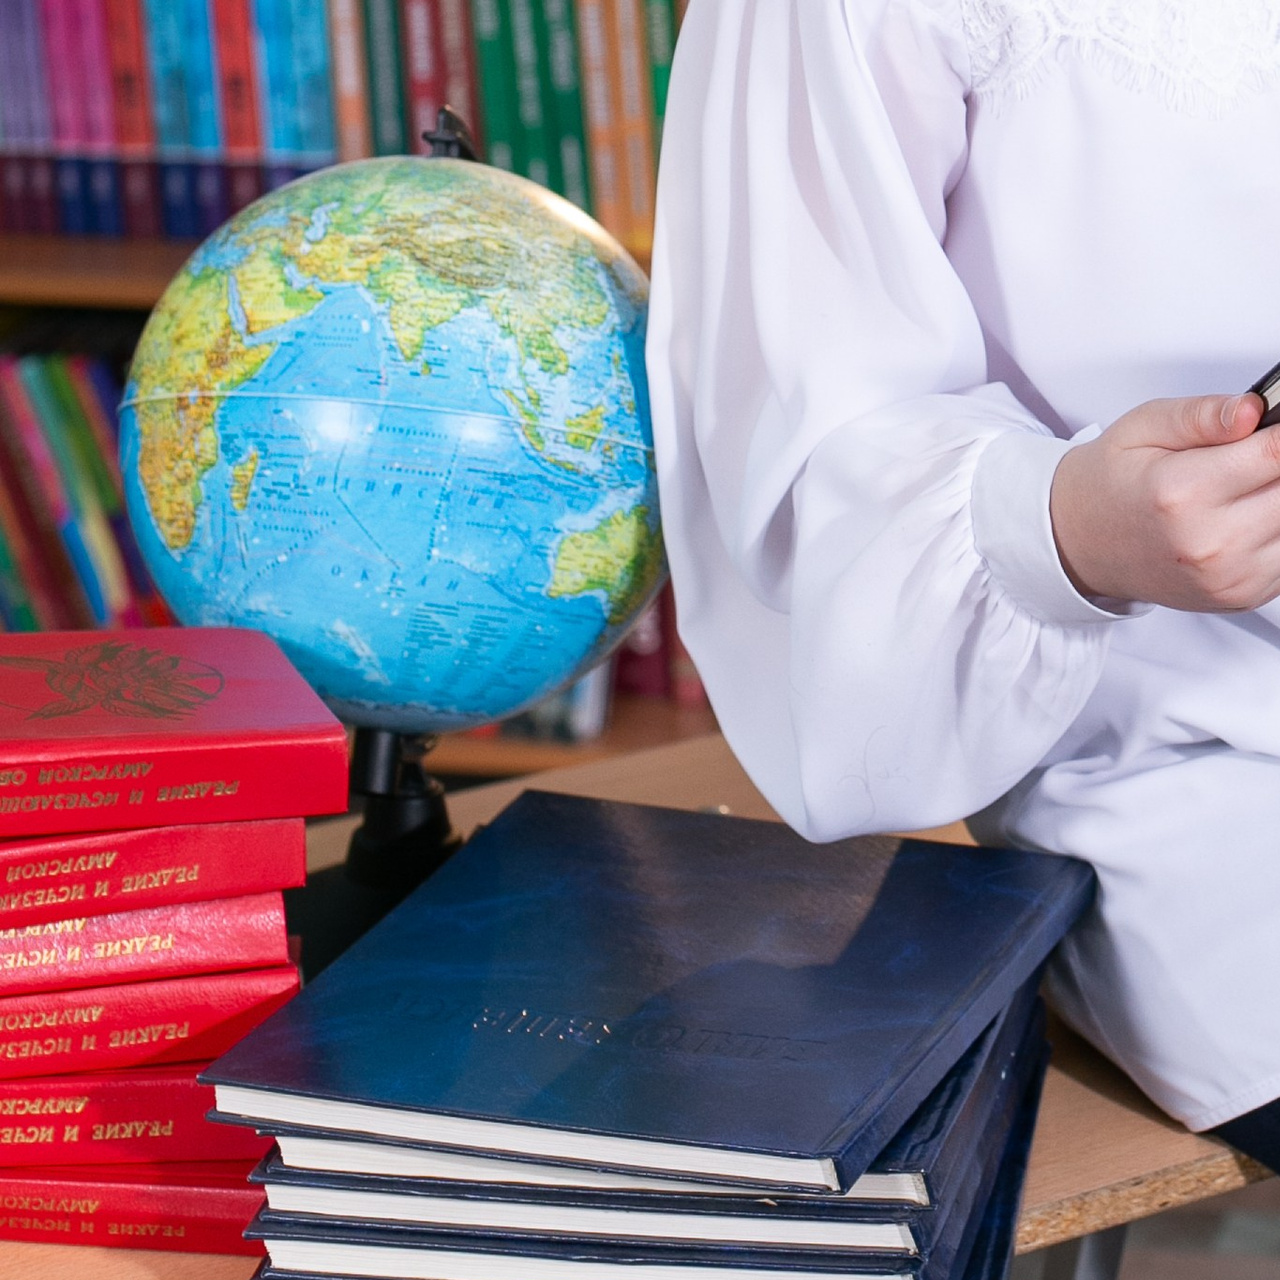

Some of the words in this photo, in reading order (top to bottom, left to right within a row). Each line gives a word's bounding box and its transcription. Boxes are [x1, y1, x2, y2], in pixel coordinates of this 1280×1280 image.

[330, 564, 460, 592] ОКЕАН
[38, 761, 154, 786] АМУРСКОЙ
[129, 788, 145, 805] И
[156, 779, 240, 803] РЕДКИЕ
[6, 851, 118, 884] АМУРСКОЙ
[121, 864, 200, 893] РЕДКИЕ
[94, 880, 111, 897] И
[66, 945, 82, 962] И
[94, 932, 175, 959] РЕДКИЕ
[0, 949, 58, 972] ИСЧЕ
[0, 1004, 101, 1032] АМУРСКО
[81, 1034, 97, 1051] И
[108, 1021, 191, 1049] РЕДКИЕ
[0, 1095, 91, 1116] АМУРСК
[63, 1124, 80, 1142] И
[92, 1119, 175, 1142] РЕДКИЕ
[0, 1195, 100, 1215] АМУРСКО
[80, 1222, 95, 1234] И
[107, 1223, 187, 1239] РЕДКИЕ
